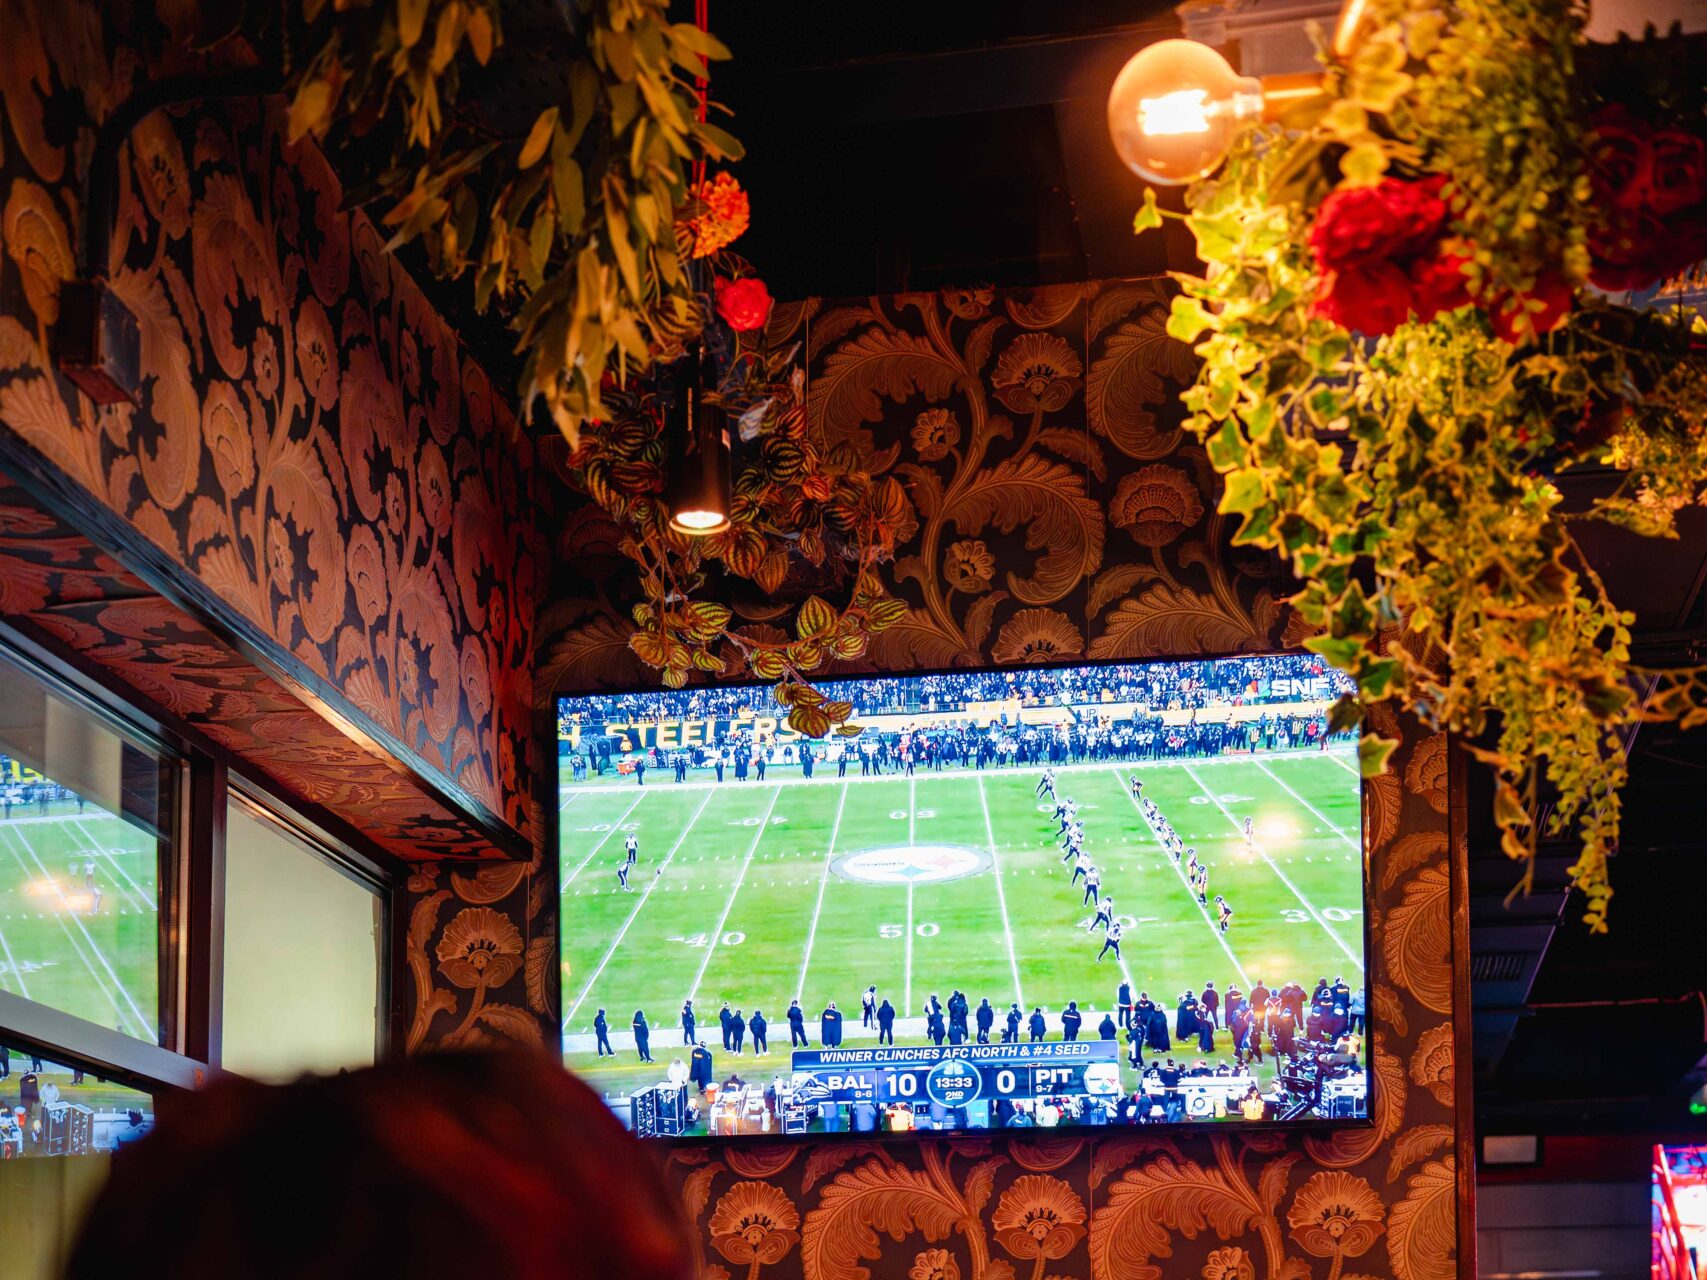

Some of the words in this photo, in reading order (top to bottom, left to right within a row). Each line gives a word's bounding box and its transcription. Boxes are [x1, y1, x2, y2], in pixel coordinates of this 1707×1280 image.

[1271, 677, 1330, 696] SNF
[820, 1051, 873, 1063] WINNER
[875, 1048, 940, 1061] CLINCHES
[942, 1047, 969, 1059] AFC
[971, 1045, 1018, 1058] NORTH
[1020, 1045, 1030, 1057] &
[1033, 1044, 1052, 1056] #4
[1055, 1043, 1090, 1055] SEED
[828, 1074, 873, 1090] BAL
[886, 1073, 917, 1097] 10
[935, 1077, 973, 1089] 13:33
[996, 1070, 1016, 1093] 0
[1035, 1068, 1073, 1083] PIT
[1035, 1084, 1053, 1093] 9-7
